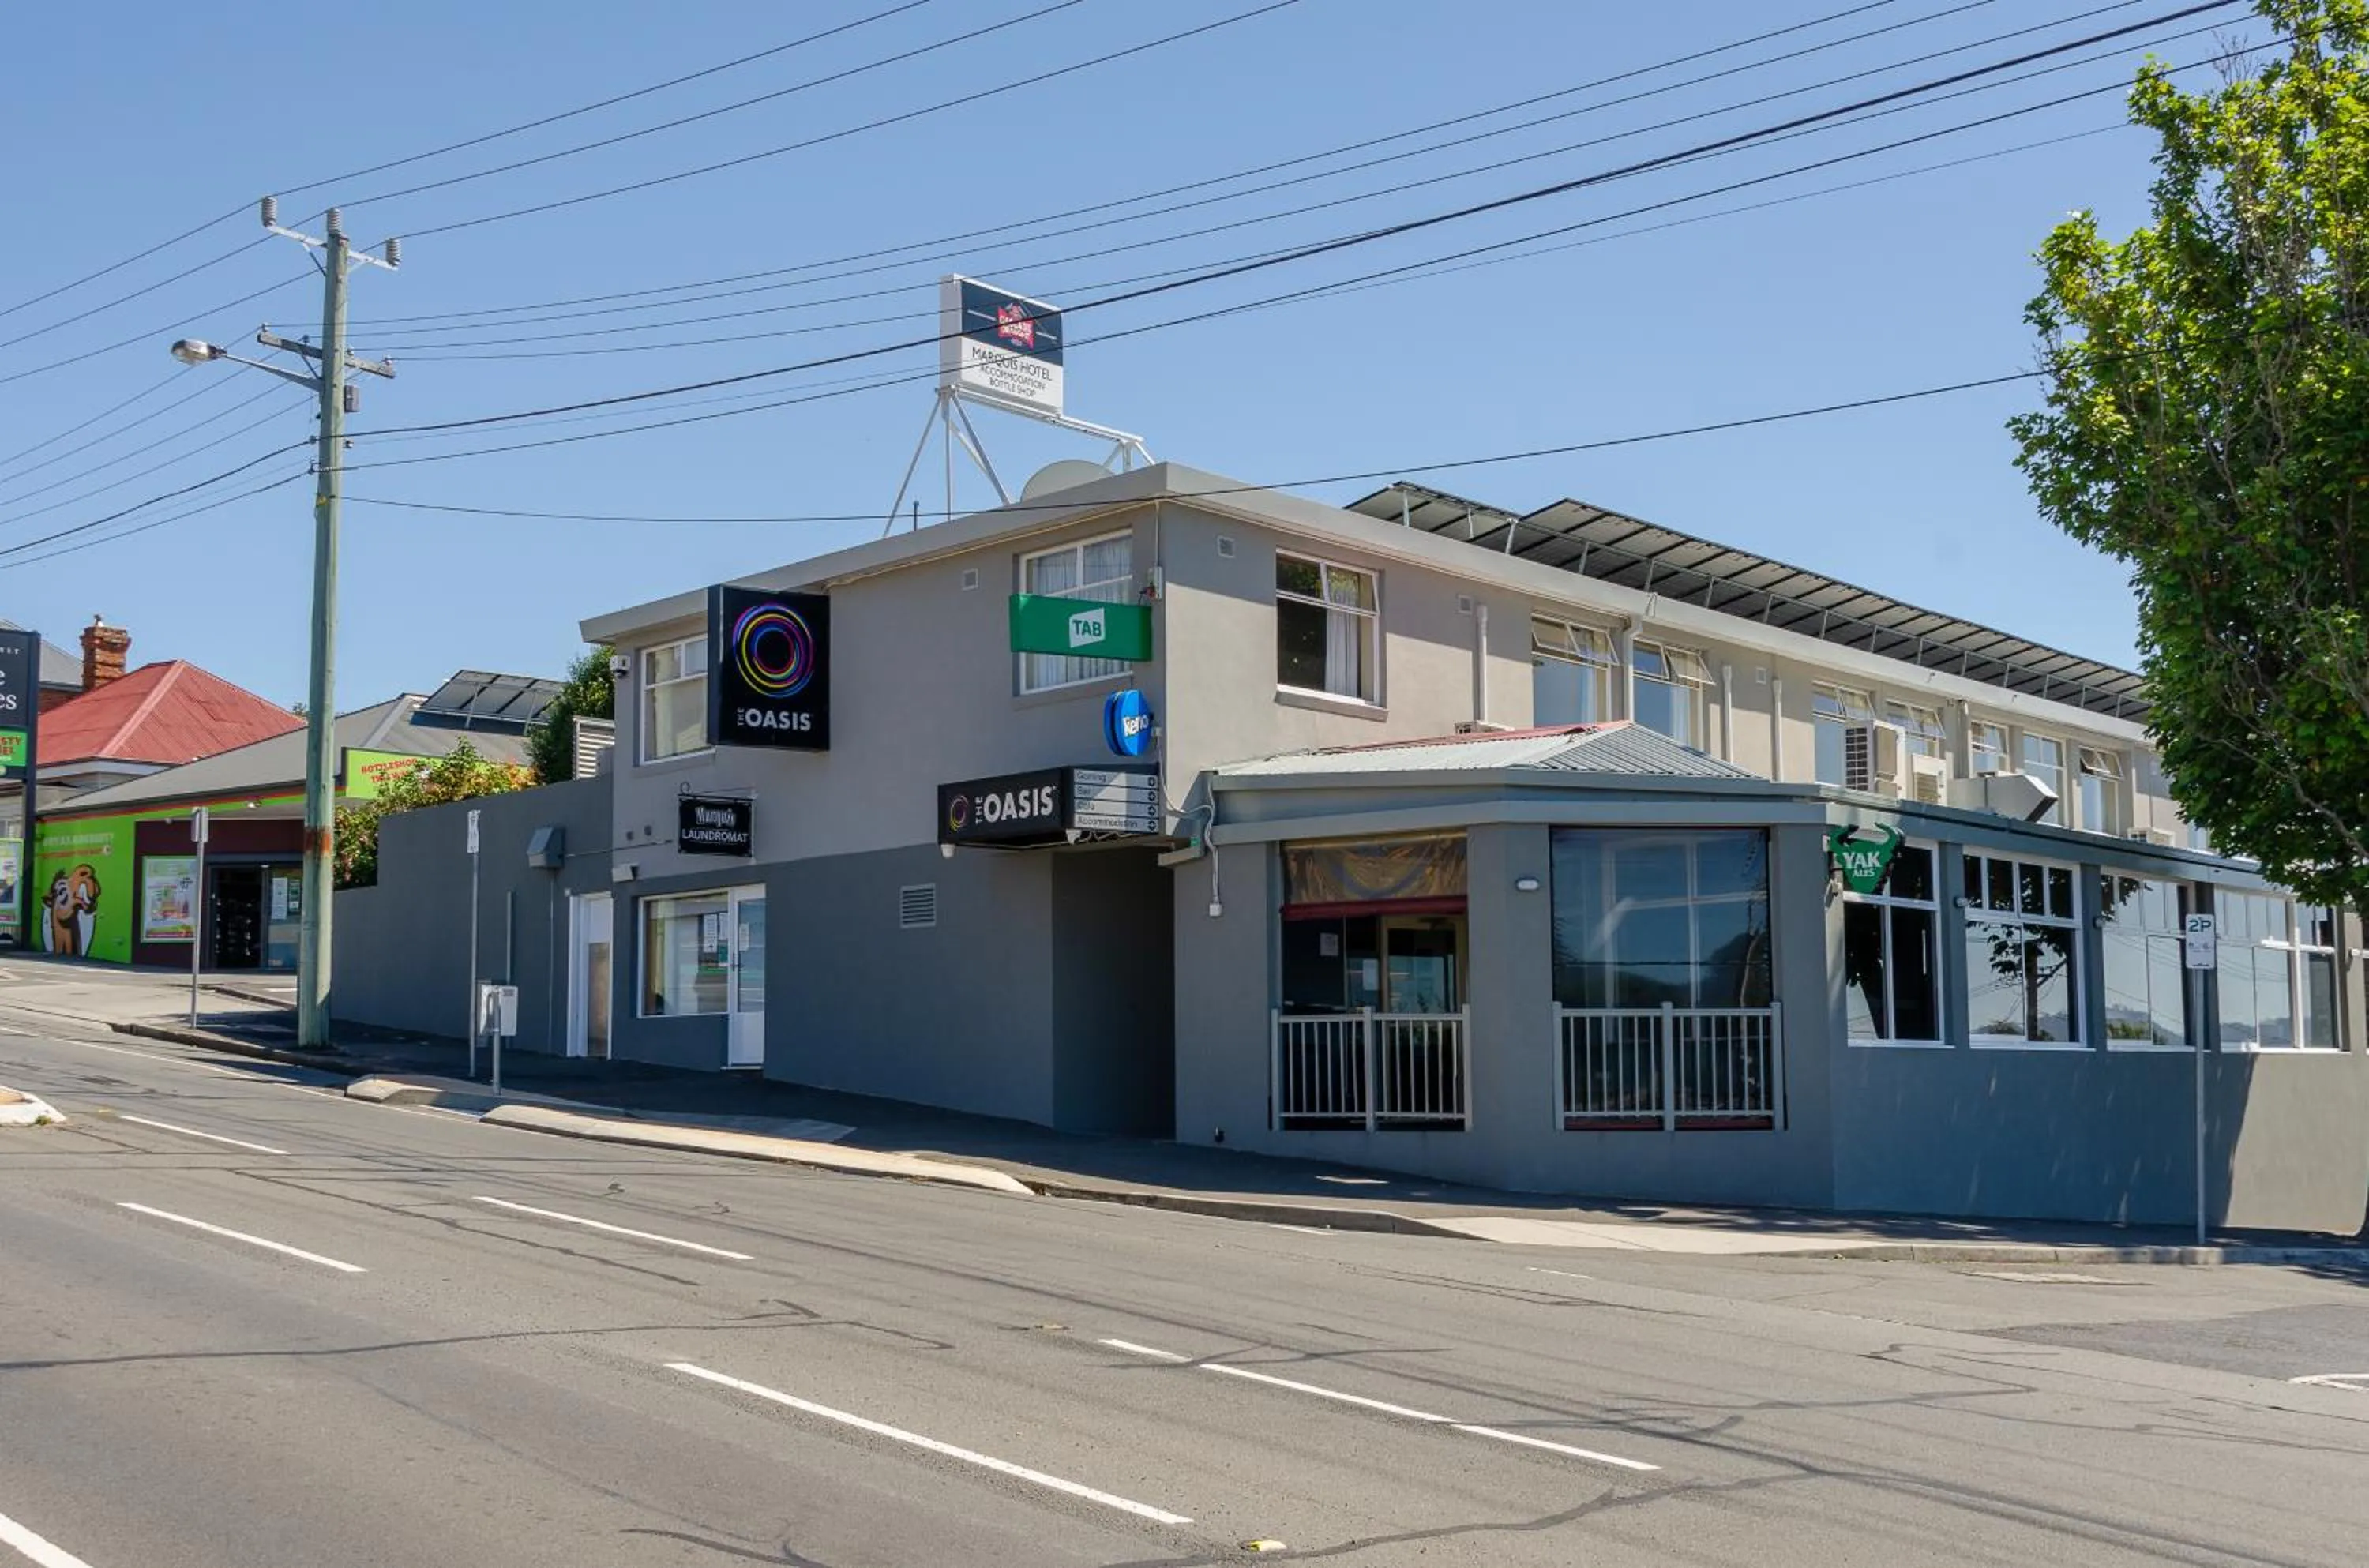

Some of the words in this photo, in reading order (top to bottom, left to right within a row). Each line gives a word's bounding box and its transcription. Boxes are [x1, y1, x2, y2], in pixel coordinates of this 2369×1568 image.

[972, 347, 1018, 370] MARQUIS
[1020, 362, 1053, 381] HOTEL
[980, 365, 1046, 391] ACCOMMODATION
[989, 377, 1016, 392] BOTTLE
[1017, 384, 1037, 396] SHOP
[1072, 619, 1102, 637] TAB
[745, 707, 812, 731] OASIS
[1123, 715, 1149, 737] Keno
[974, 796, 983, 825] THE
[983, 785, 1053, 823] OASIS
[681, 828, 749, 843] LAUNDROMAT
[1842, 850, 1883, 869] YAK
[1853, 868, 1876, 878] ALES
[2188, 919, 2212, 932] 2P
